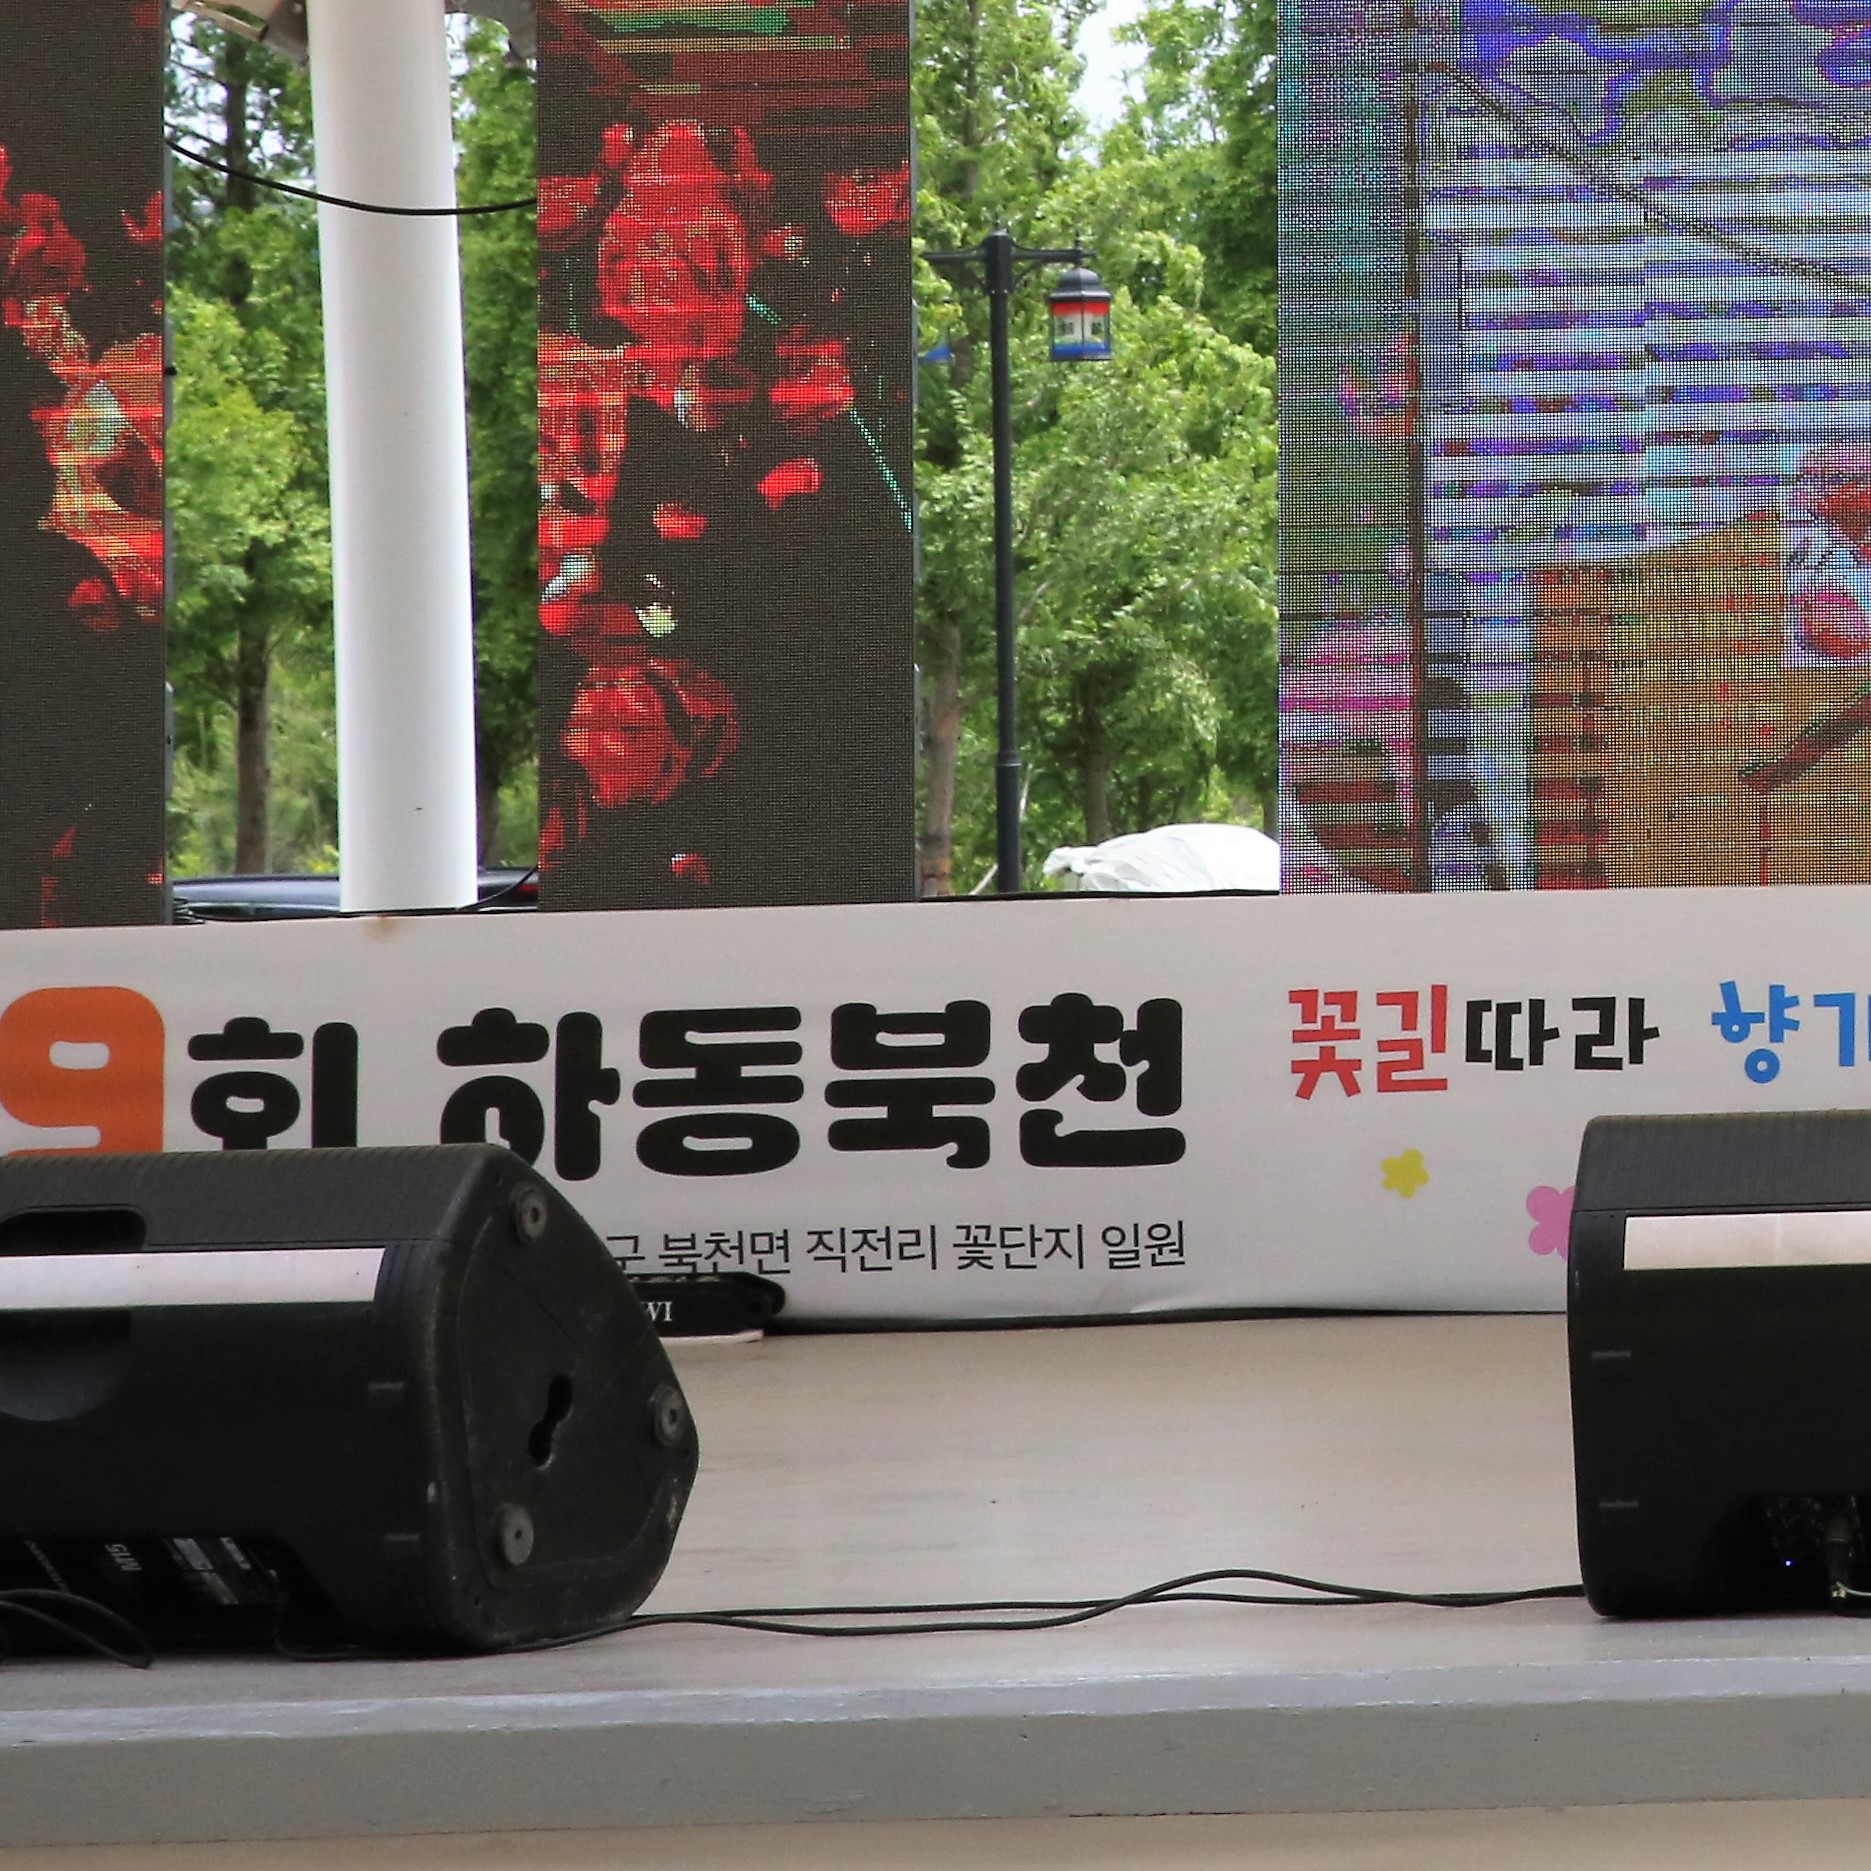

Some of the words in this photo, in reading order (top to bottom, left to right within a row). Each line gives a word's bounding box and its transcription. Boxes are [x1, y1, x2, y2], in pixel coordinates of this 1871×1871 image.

[436, 992, 1186, 1182] 하동북천
[1288, 983, 1661, 1101] 꽃길따라
[658, 1228, 791, 1275] 북천면
[806, 1224, 939, 1272] 직전리
[952, 1220, 1087, 1271] 꽃단지
[1101, 1217, 1187, 1269] 일원
